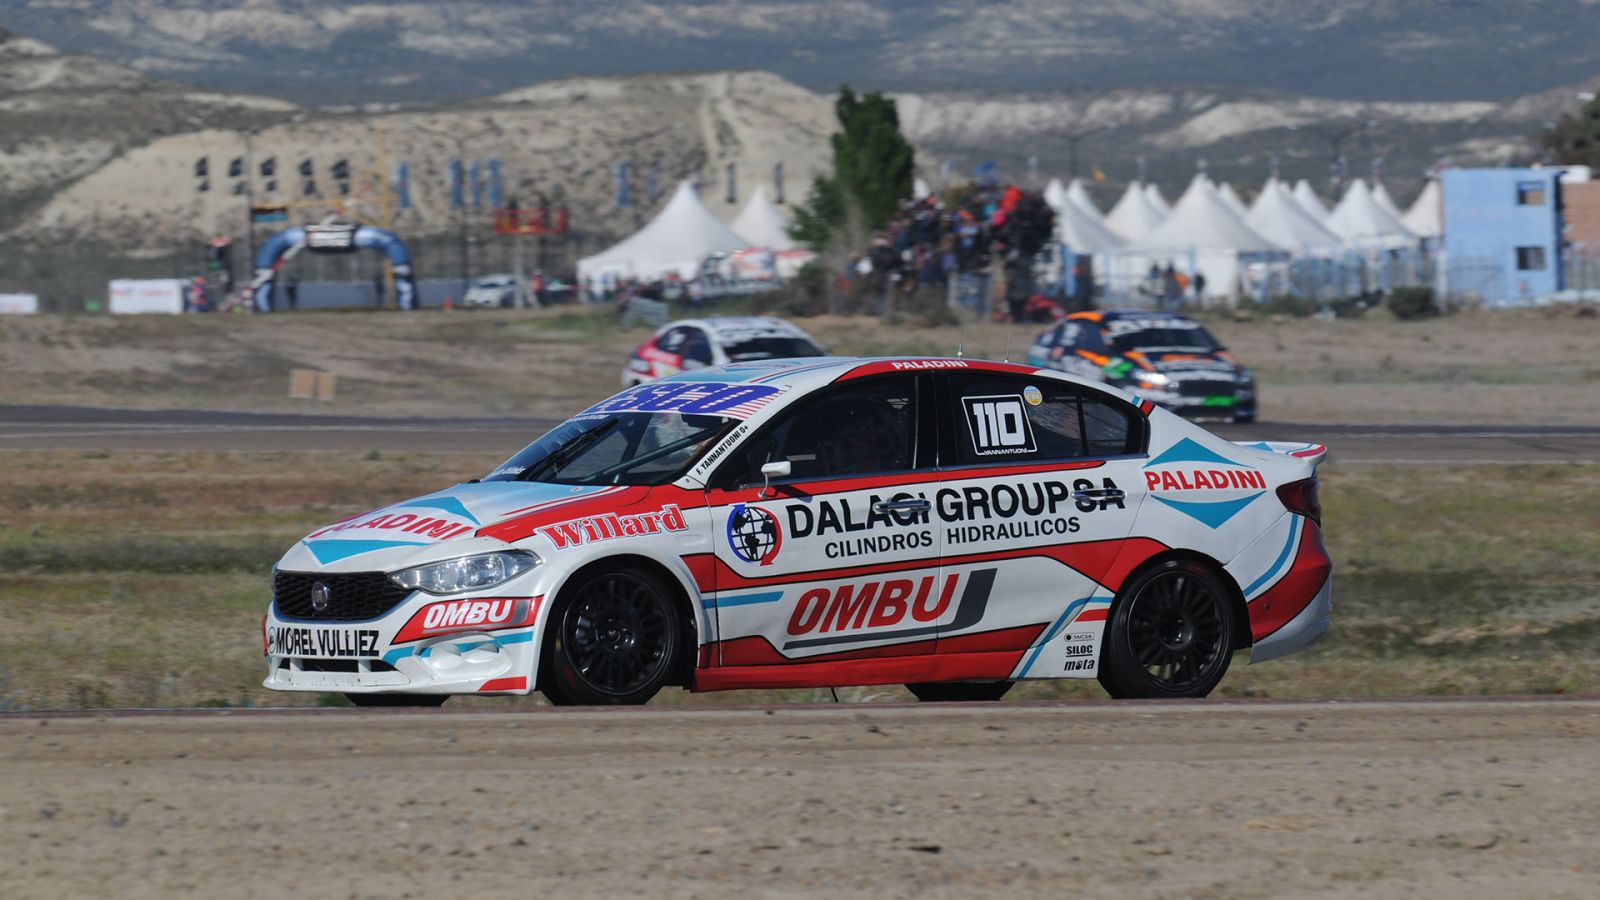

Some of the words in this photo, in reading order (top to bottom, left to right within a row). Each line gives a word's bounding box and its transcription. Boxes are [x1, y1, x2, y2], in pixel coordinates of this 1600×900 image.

[891, 361, 969, 370] PALADINI
[972, 401, 1026, 447] 110
[700, 431, 742, 470] YANNANTUONI
[984, 448, 1028, 456] YANNANTUONI
[1144, 470, 1267, 491] PALADINI
[786, 492, 930, 539] DALAGI
[936, 481, 1069, 522] GROUP
[1073, 477, 1126, 513] SA
[534, 504, 688, 549] Willard
[825, 531, 933, 559] CILINDROS
[947, 516, 1081, 545] HIDRAULICOS
[423, 599, 513, 629] OMBU
[787, 573, 960, 636] OMBU
[276, 627, 317, 656] MOREL
[317, 629, 380, 657] VULLIEZ
[1066, 644, 1093, 655] SILOC
